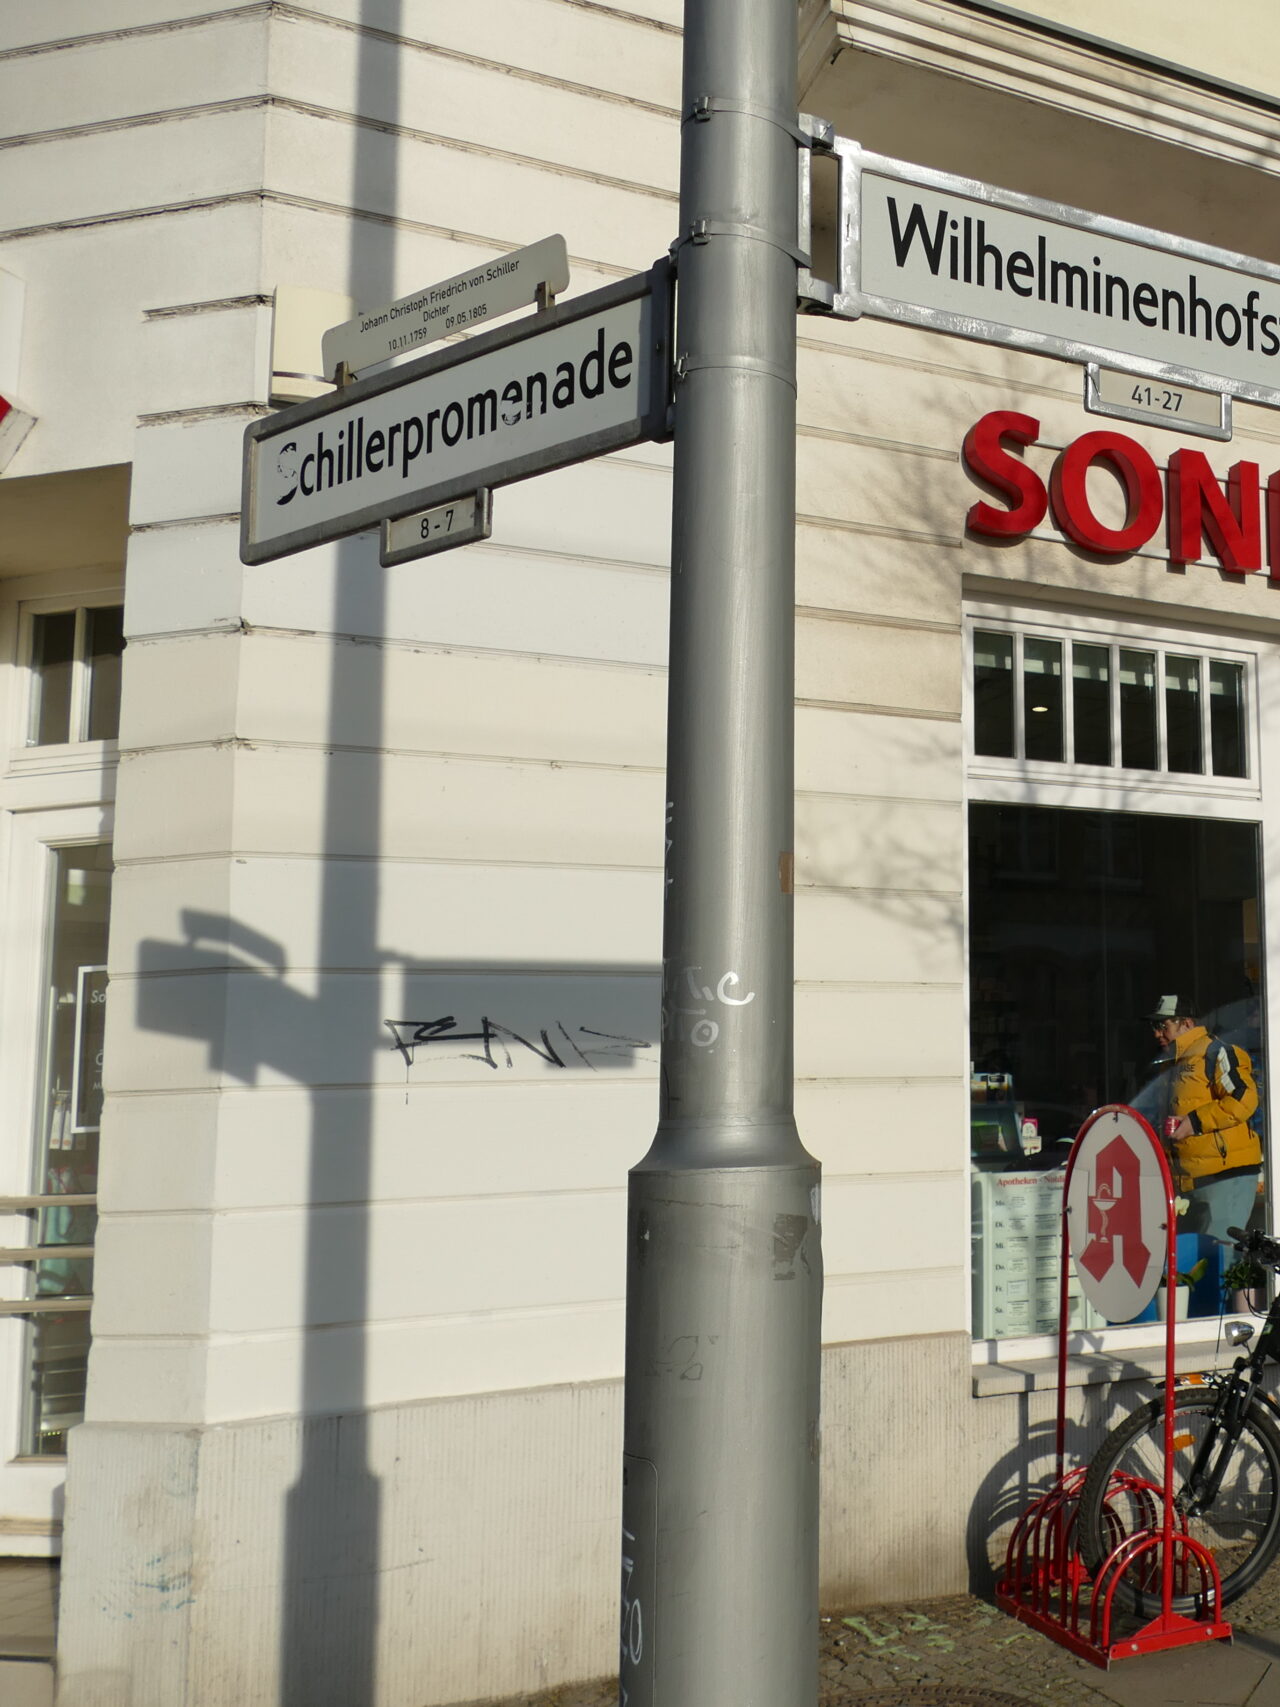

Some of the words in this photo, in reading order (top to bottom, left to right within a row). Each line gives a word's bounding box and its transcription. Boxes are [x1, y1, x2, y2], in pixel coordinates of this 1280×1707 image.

[360, 313, 389, 333] Johann
[390, 296, 429, 319] Christoph
[430, 282, 468, 306] Friedrich
[469, 275, 485, 288] von
[486, 260, 520, 282] Schiller
[423, 304, 450, 323] Dichter
[388, 327, 428, 351] 10.11.1759
[445, 304, 488, 329] 09.05.1805
[276, 329, 633, 505] Schillerpromenade
[1131, 384, 1183, 413] 41-27
[997, 1177, 1038, 1188] Apotheken
